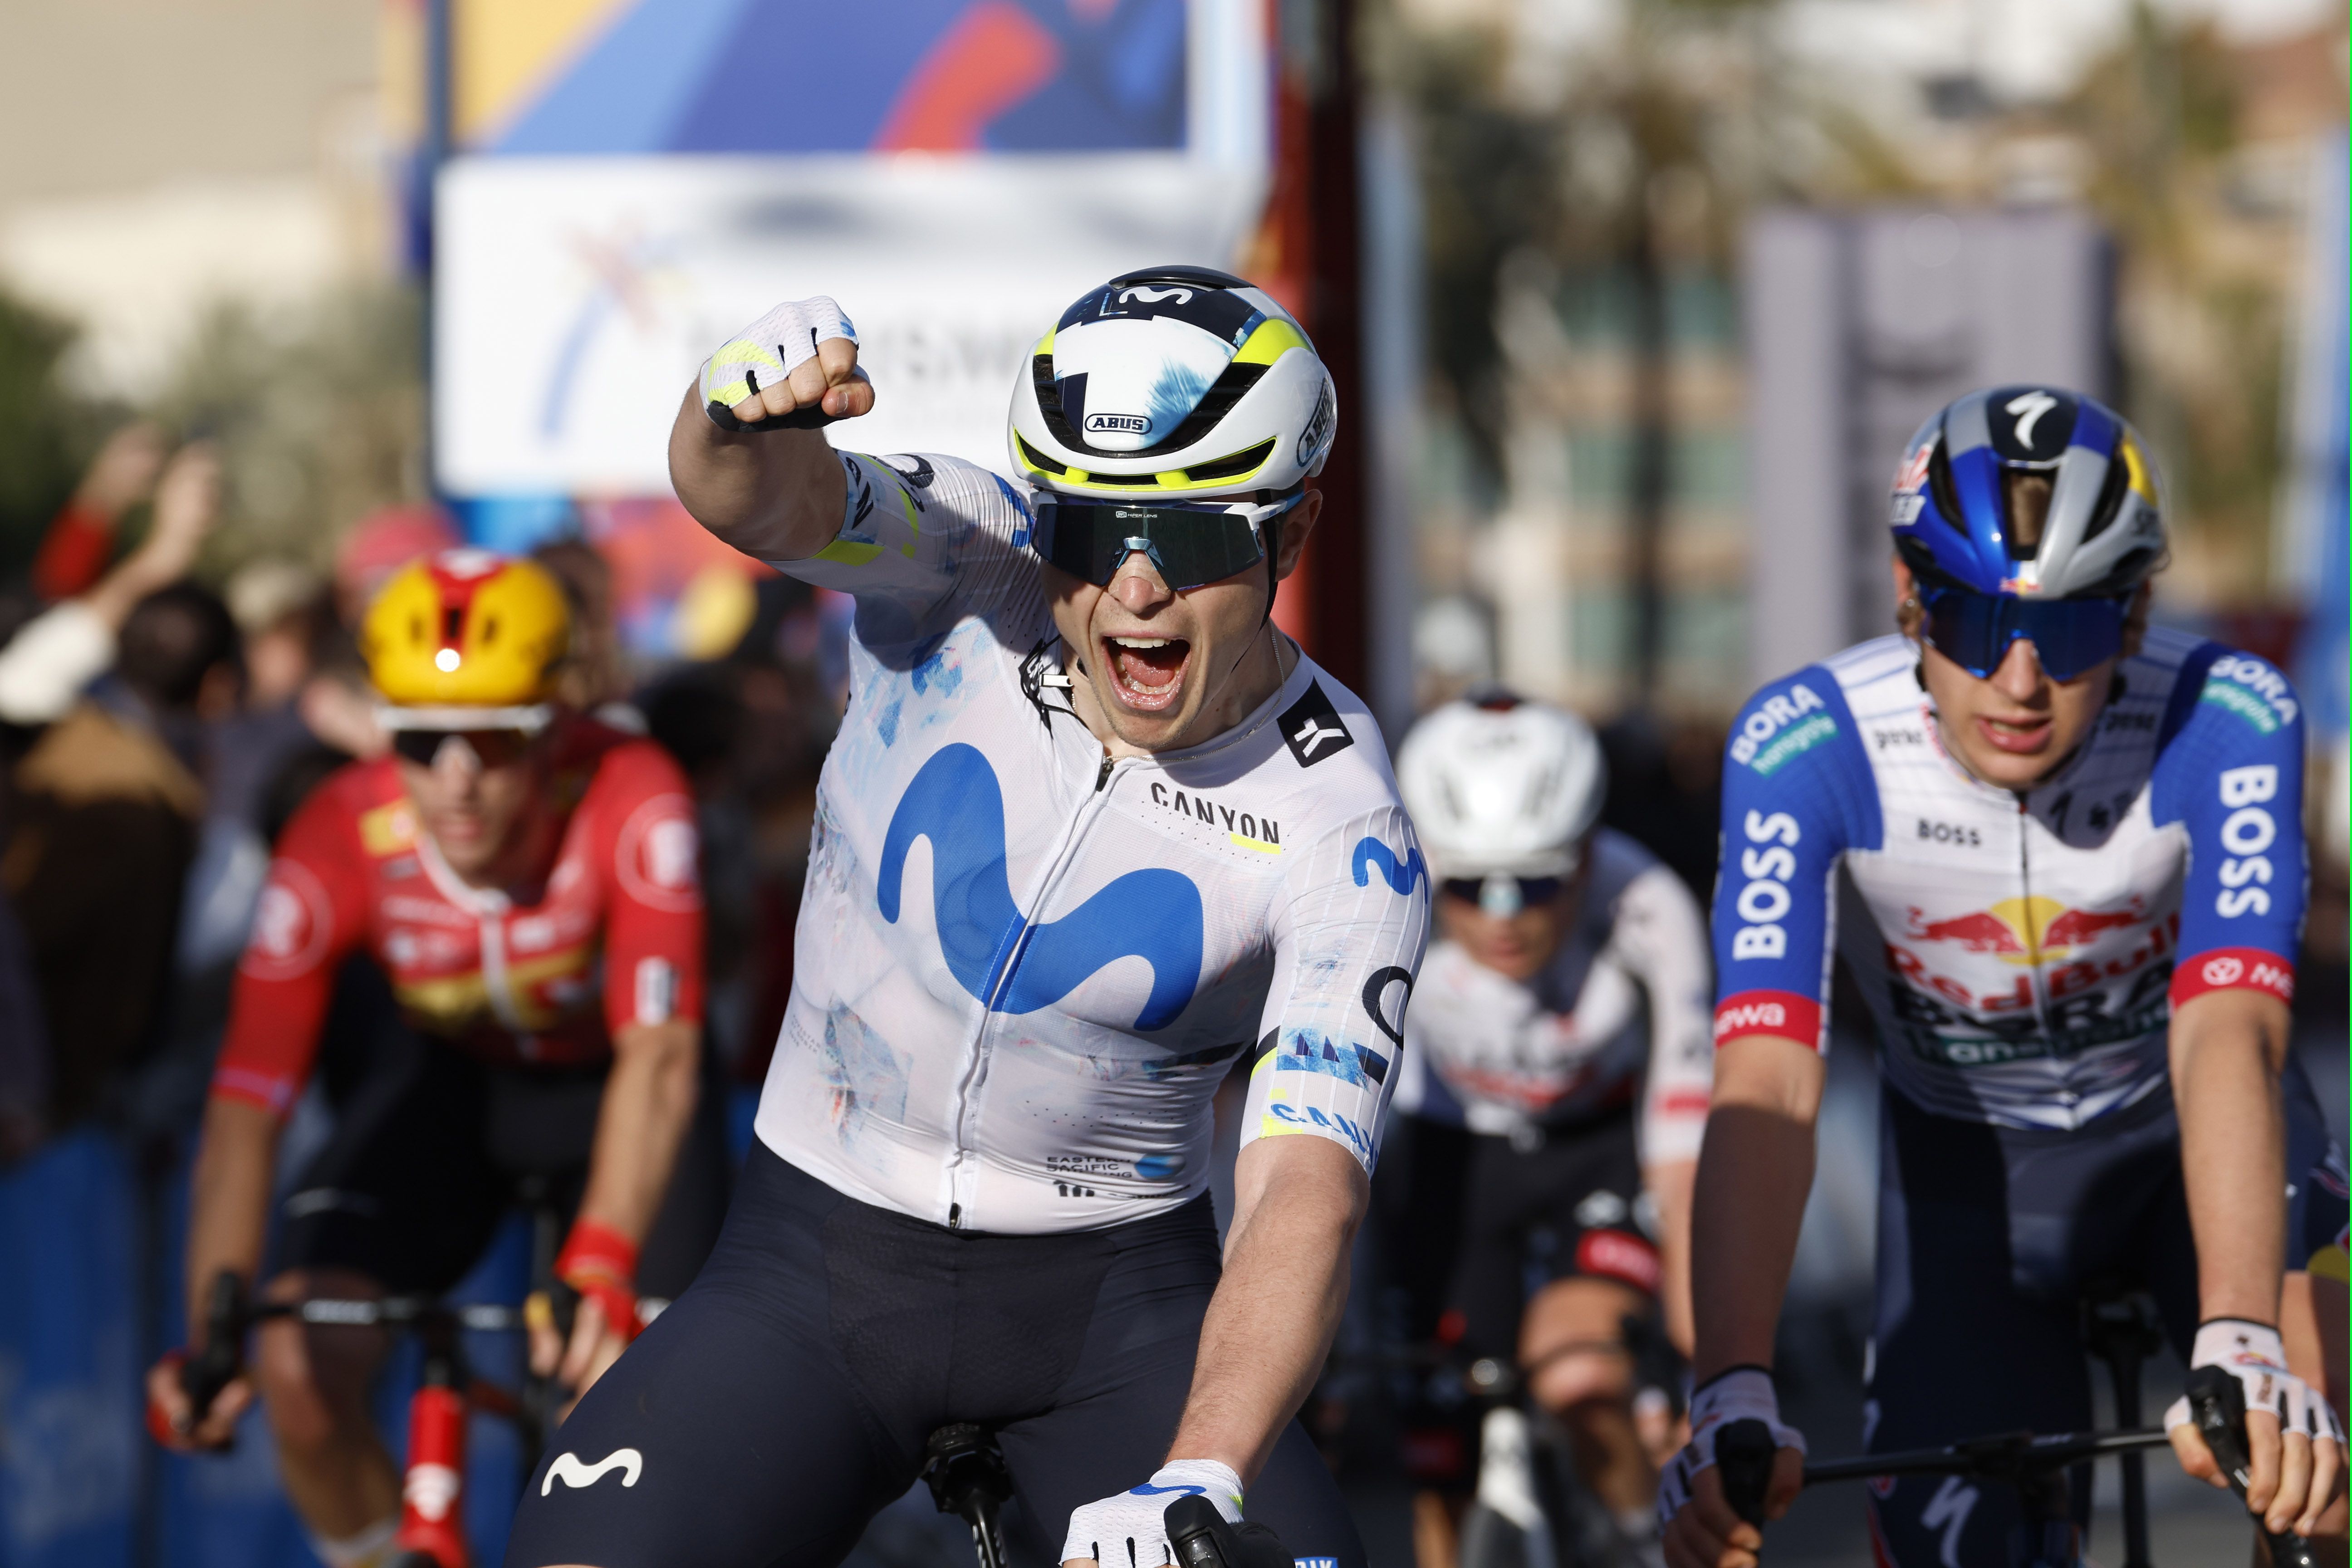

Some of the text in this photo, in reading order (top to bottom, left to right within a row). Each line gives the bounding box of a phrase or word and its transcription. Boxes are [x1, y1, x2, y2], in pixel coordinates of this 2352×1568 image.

[1093, 417, 1143, 431] ABUS
[1730, 683, 1826, 765] BORA
[1151, 782, 1279, 844] CANYON
[1918, 818, 1981, 848] BOSS
[2215, 764, 2278, 919] BOSS
[1732, 809, 1801, 960] BOSS
[1271, 1103, 1378, 1171] CANY
